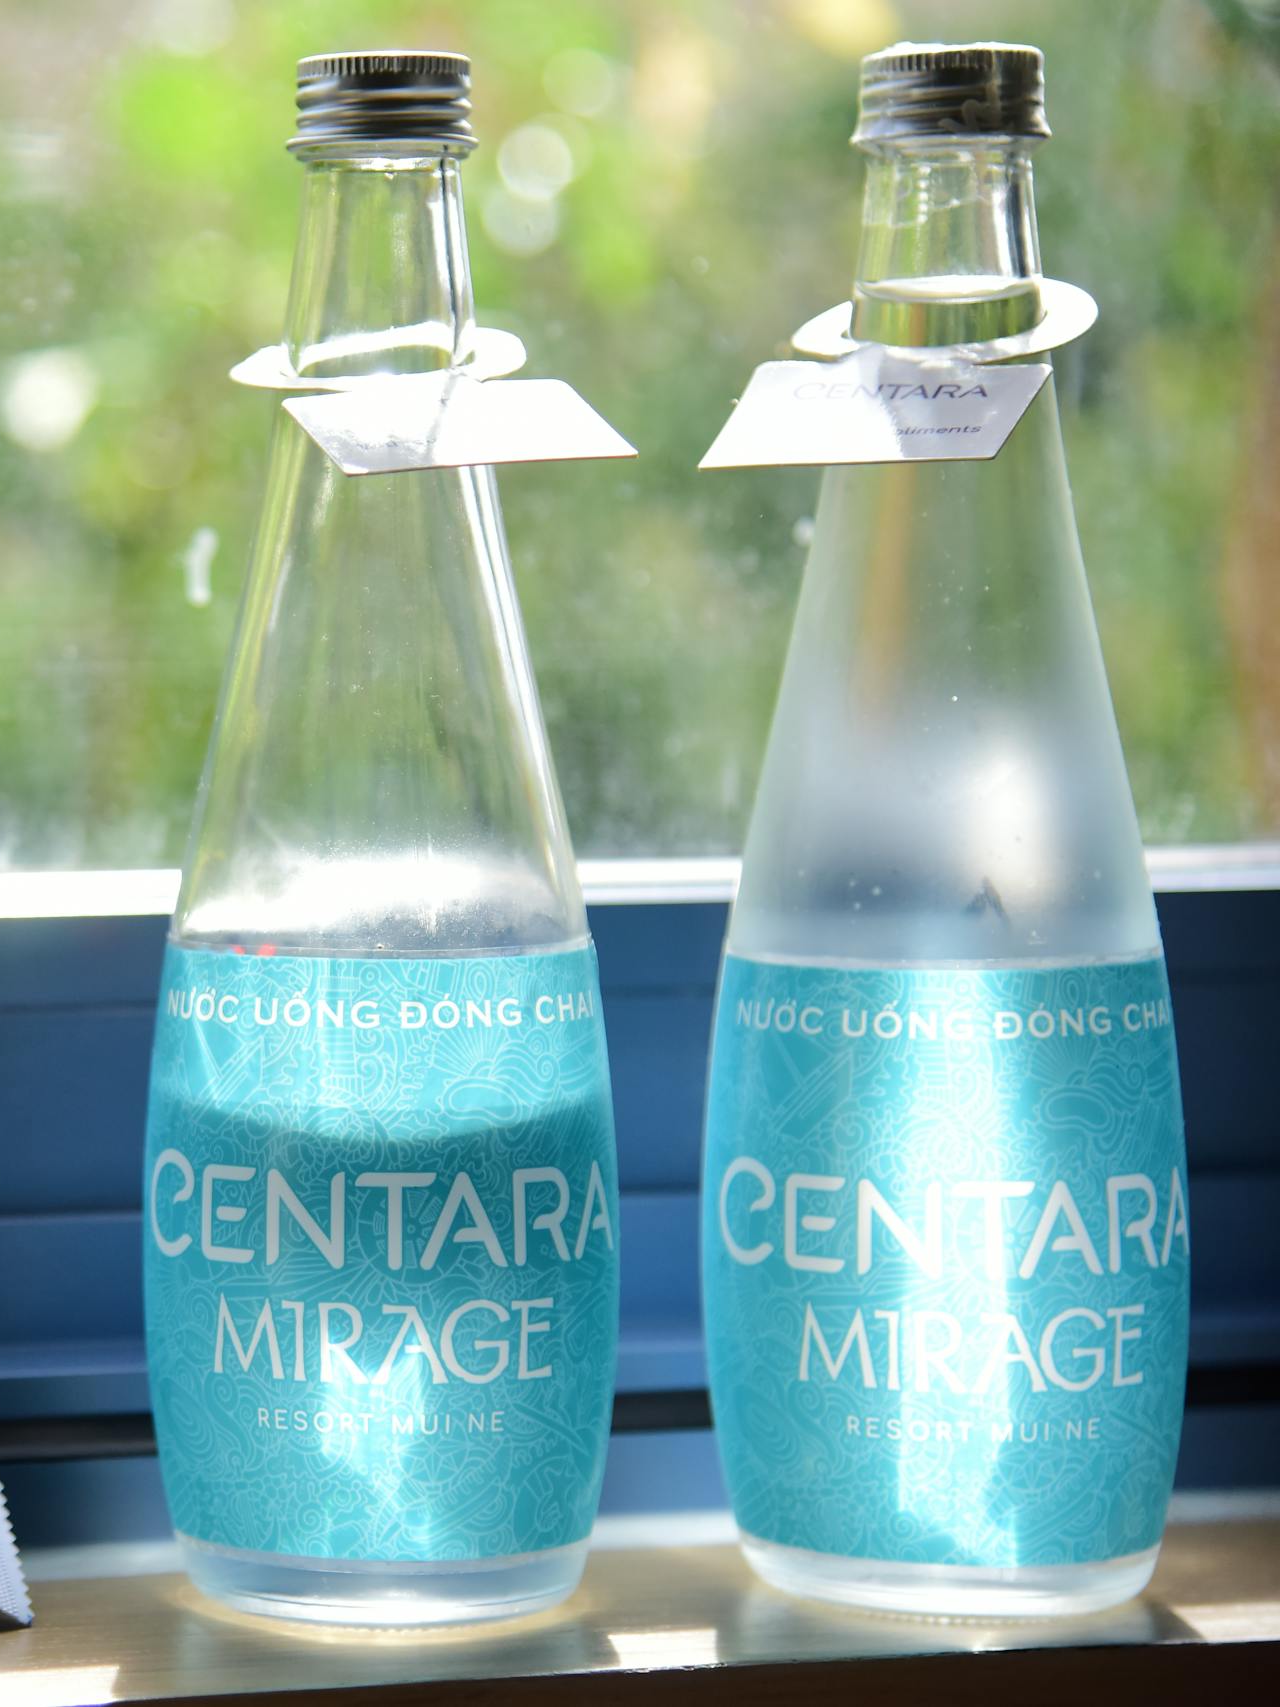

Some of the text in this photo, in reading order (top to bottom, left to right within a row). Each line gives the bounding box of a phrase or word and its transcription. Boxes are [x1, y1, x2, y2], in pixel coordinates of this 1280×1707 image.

[793, 382, 988, 400] CENTARA
[254, 987, 381, 1029] UỐNG
[398, 993, 522, 1030] ĐÓNG
[736, 998, 824, 1035] NƯỚC
[841, 1000, 973, 1041] UỐNG
[993, 1003, 1112, 1040] ĐÓNG
[150, 1147, 615, 1272] CENTARA
[720, 1155, 1190, 1280] CENTARA
[213, 1292, 554, 1385] MIRAGE
[798, 1300, 1146, 1394] MIRAGE
[257, 1407, 505, 1434] RESORT MUI NE
[847, 1415, 1101, 1443] RESORT MUI NE
